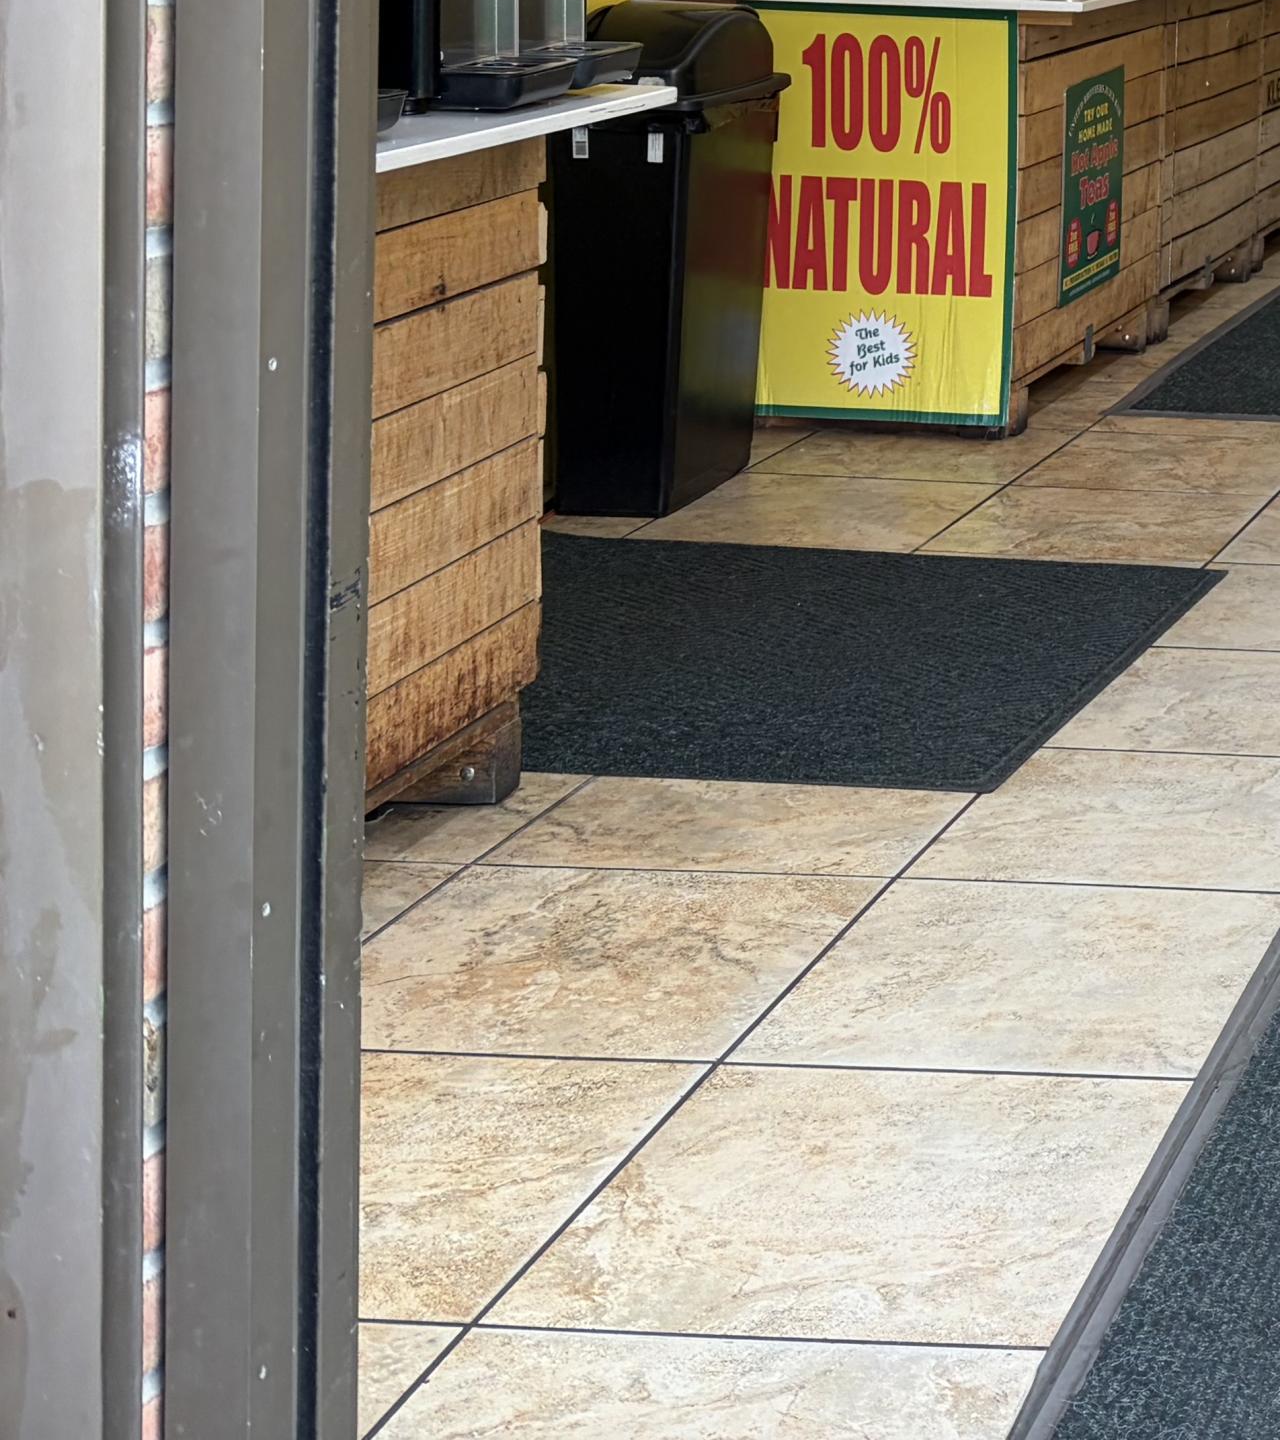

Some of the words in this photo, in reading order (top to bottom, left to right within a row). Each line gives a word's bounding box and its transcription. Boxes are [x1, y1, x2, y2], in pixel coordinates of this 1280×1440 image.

[802, 32, 952, 155] 100%
[1084, 109, 1095, 123] TRY
[1095, 102, 1109, 119] OUR
[1078, 126, 1096, 143] HOME
[1096, 118, 1113, 138] MADE
[1079, 172, 1109, 210] Teas
[764, 174, 993, 298] NATURAL
[855, 326, 880, 341] The
[856, 339, 886, 356] Best
[849, 358, 869, 376] for
[872, 353, 900, 370] Kids
